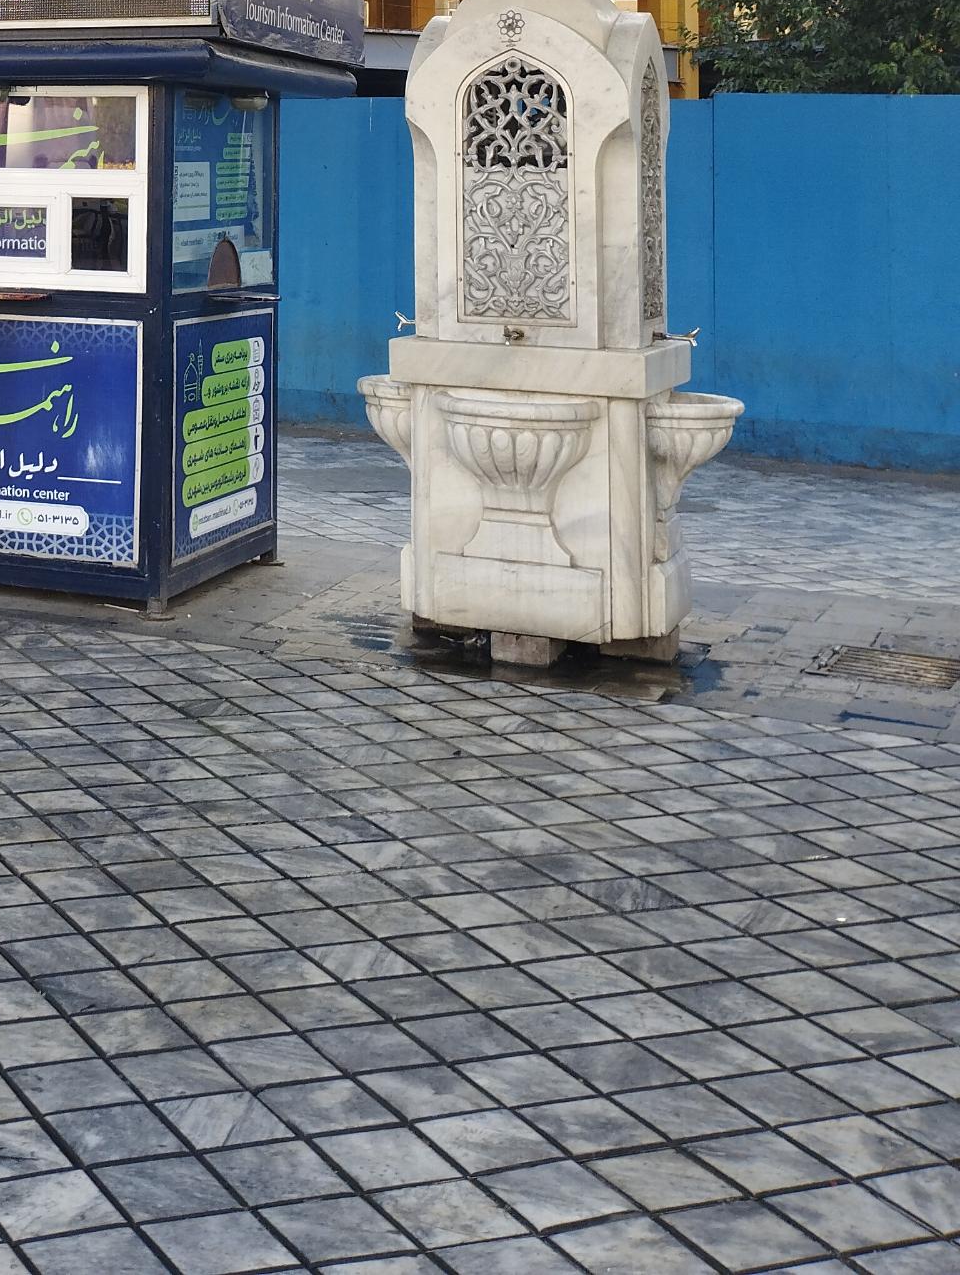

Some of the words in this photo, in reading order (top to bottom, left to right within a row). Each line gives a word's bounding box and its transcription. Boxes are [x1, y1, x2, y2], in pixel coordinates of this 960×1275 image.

[276, 5, 320, 39] Information
[320, 18, 345, 45] Center
[8, 451, 59, 480] دلیل
[33, 488, 70, 502] center
